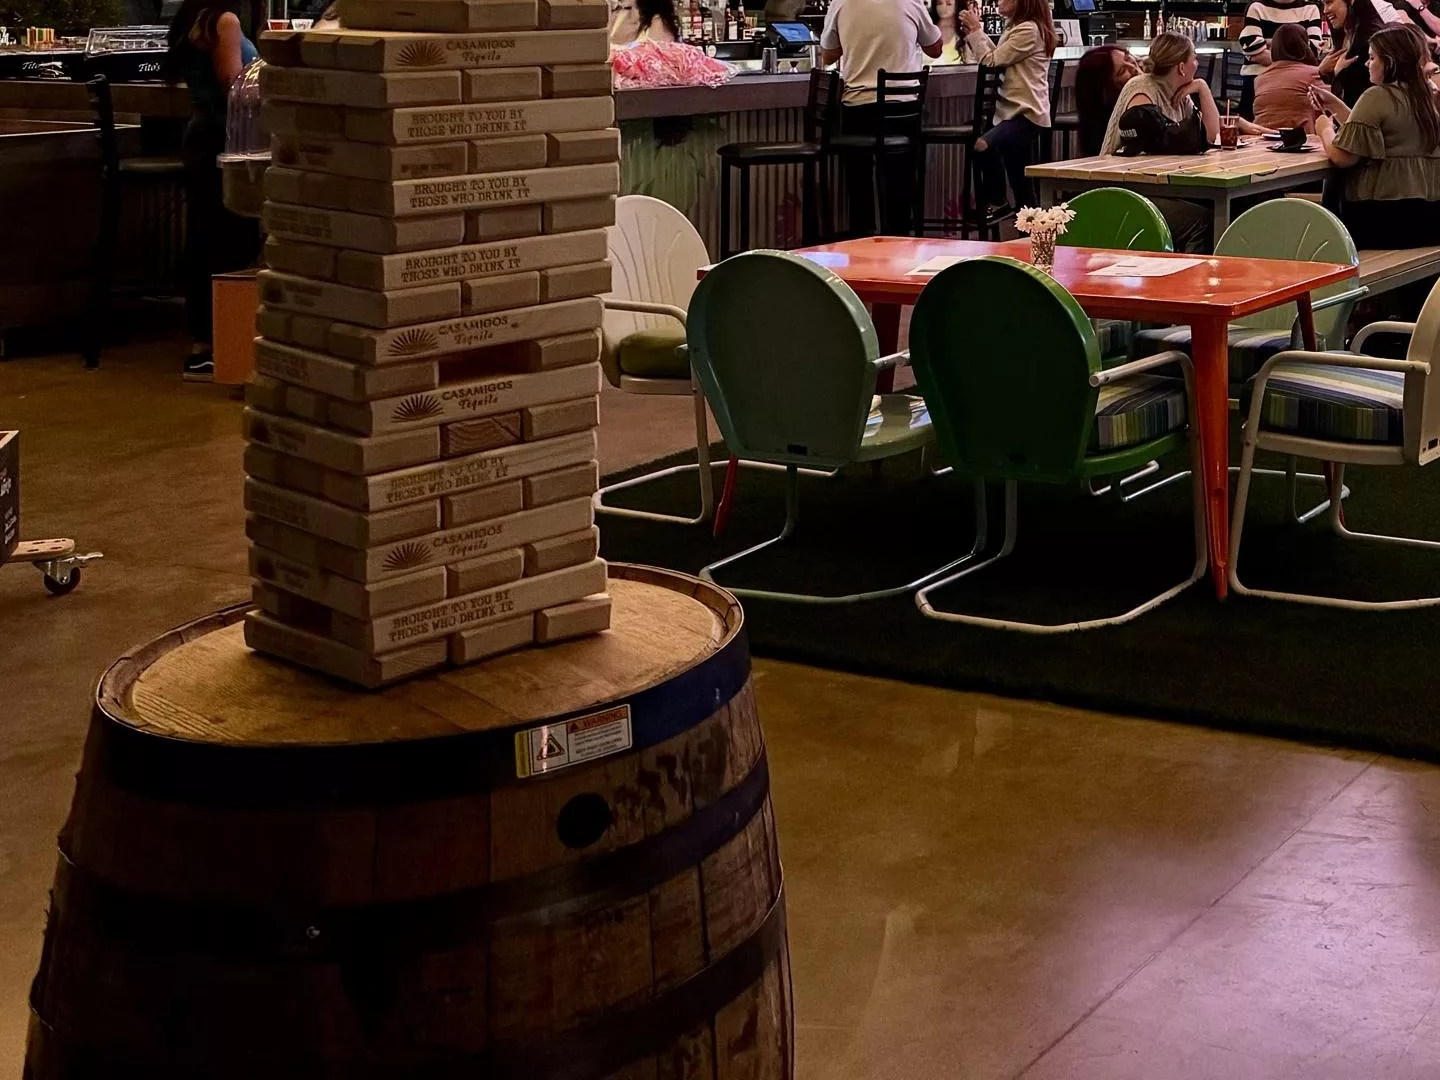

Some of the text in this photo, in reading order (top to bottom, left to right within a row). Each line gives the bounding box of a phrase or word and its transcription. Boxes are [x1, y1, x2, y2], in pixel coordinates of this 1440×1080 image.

[445, 39, 516, 51] CASAMIGOS
[138, 62, 161, 72] Tito's
[411, 109, 524, 125] BROUGHT TO YOU BY
[407, 120, 527, 138] THOSE WHO DRINK IT
[414, 176, 528, 195] BROUGHT TO YOU BY
[409, 188, 530, 209] THOSE WHO DRINK IT
[405, 247, 518, 270] BROUGHT TO YOU BY
[401, 259, 521, 283] THOSE WHO DRINK IT
[438, 316, 508, 335] CASAMIGOS
[454, 330, 494, 346] Tequila
[441, 380, 513, 401] CASAMIGOS
[457, 394, 499, 411] Tequila
[433, 524, 503, 548] CASAMIGOS
[393, 589, 510, 629] BROUGHT TO YOU BY
[389, 601, 514, 642] THOSE WHO DRINK IT
